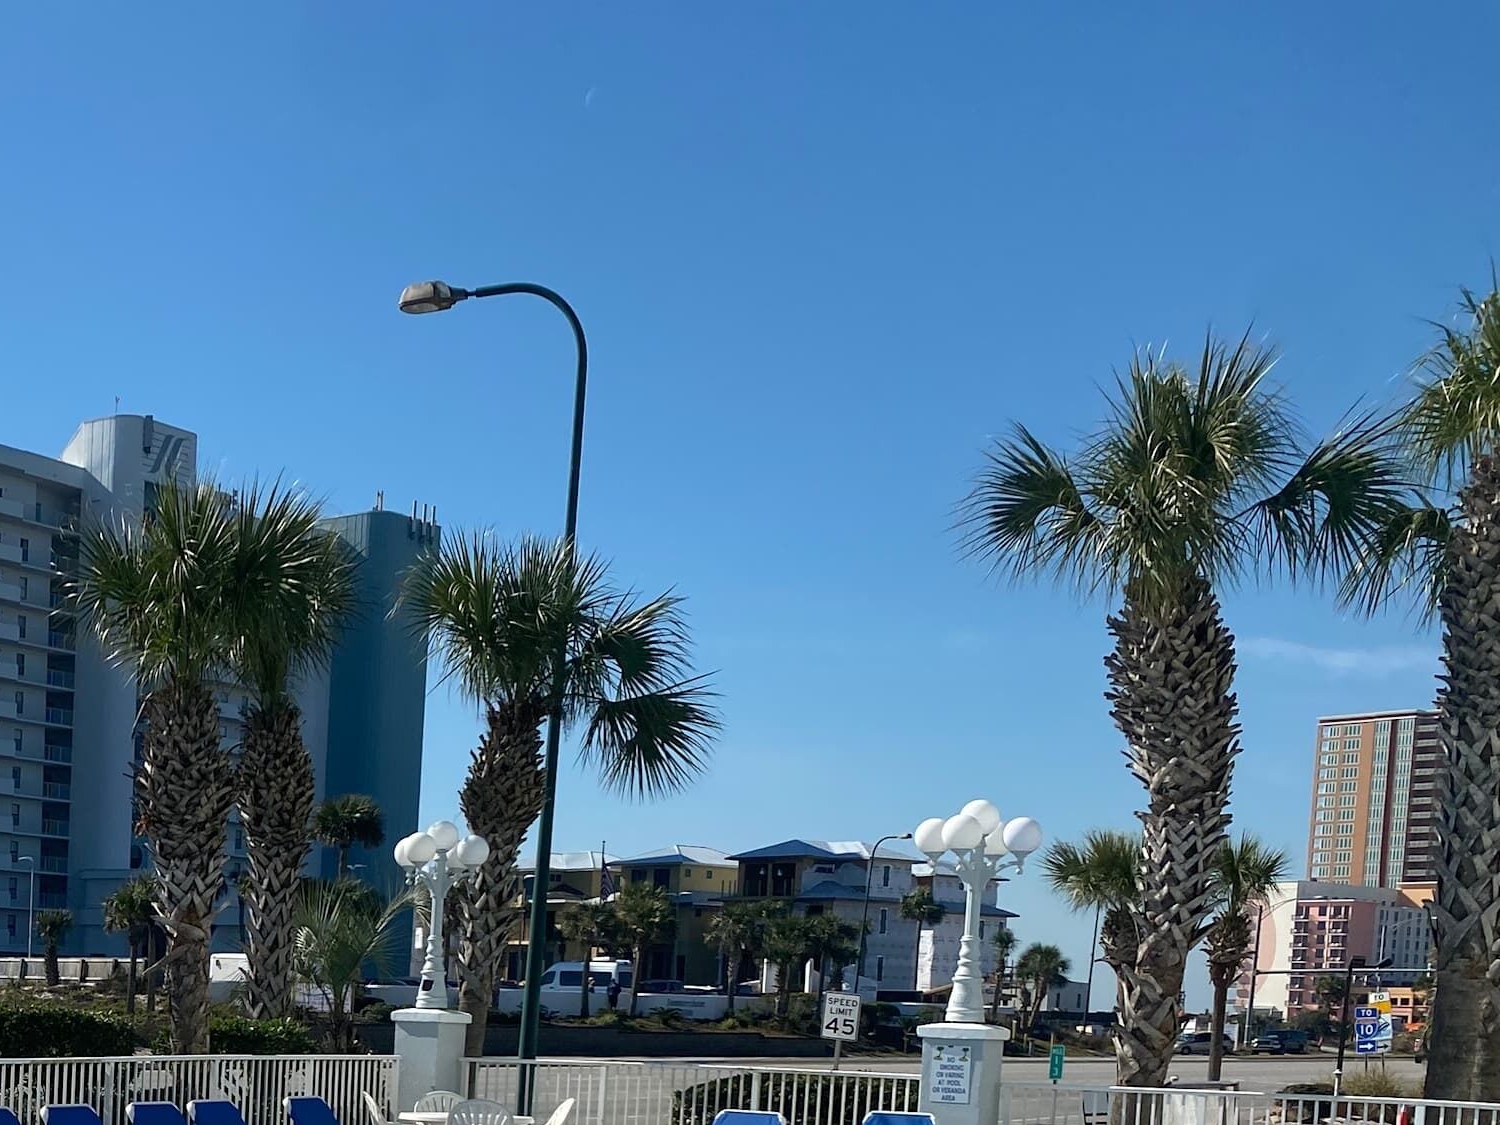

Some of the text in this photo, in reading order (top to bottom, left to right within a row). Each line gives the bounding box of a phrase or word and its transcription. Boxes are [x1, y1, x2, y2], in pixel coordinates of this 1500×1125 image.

[828, 997, 858, 1008] SPEED
[830, 1007, 853, 1016] LIMIT
[825, 1017, 855, 1035] 45
[1360, 1024, 1373, 1035] 10
